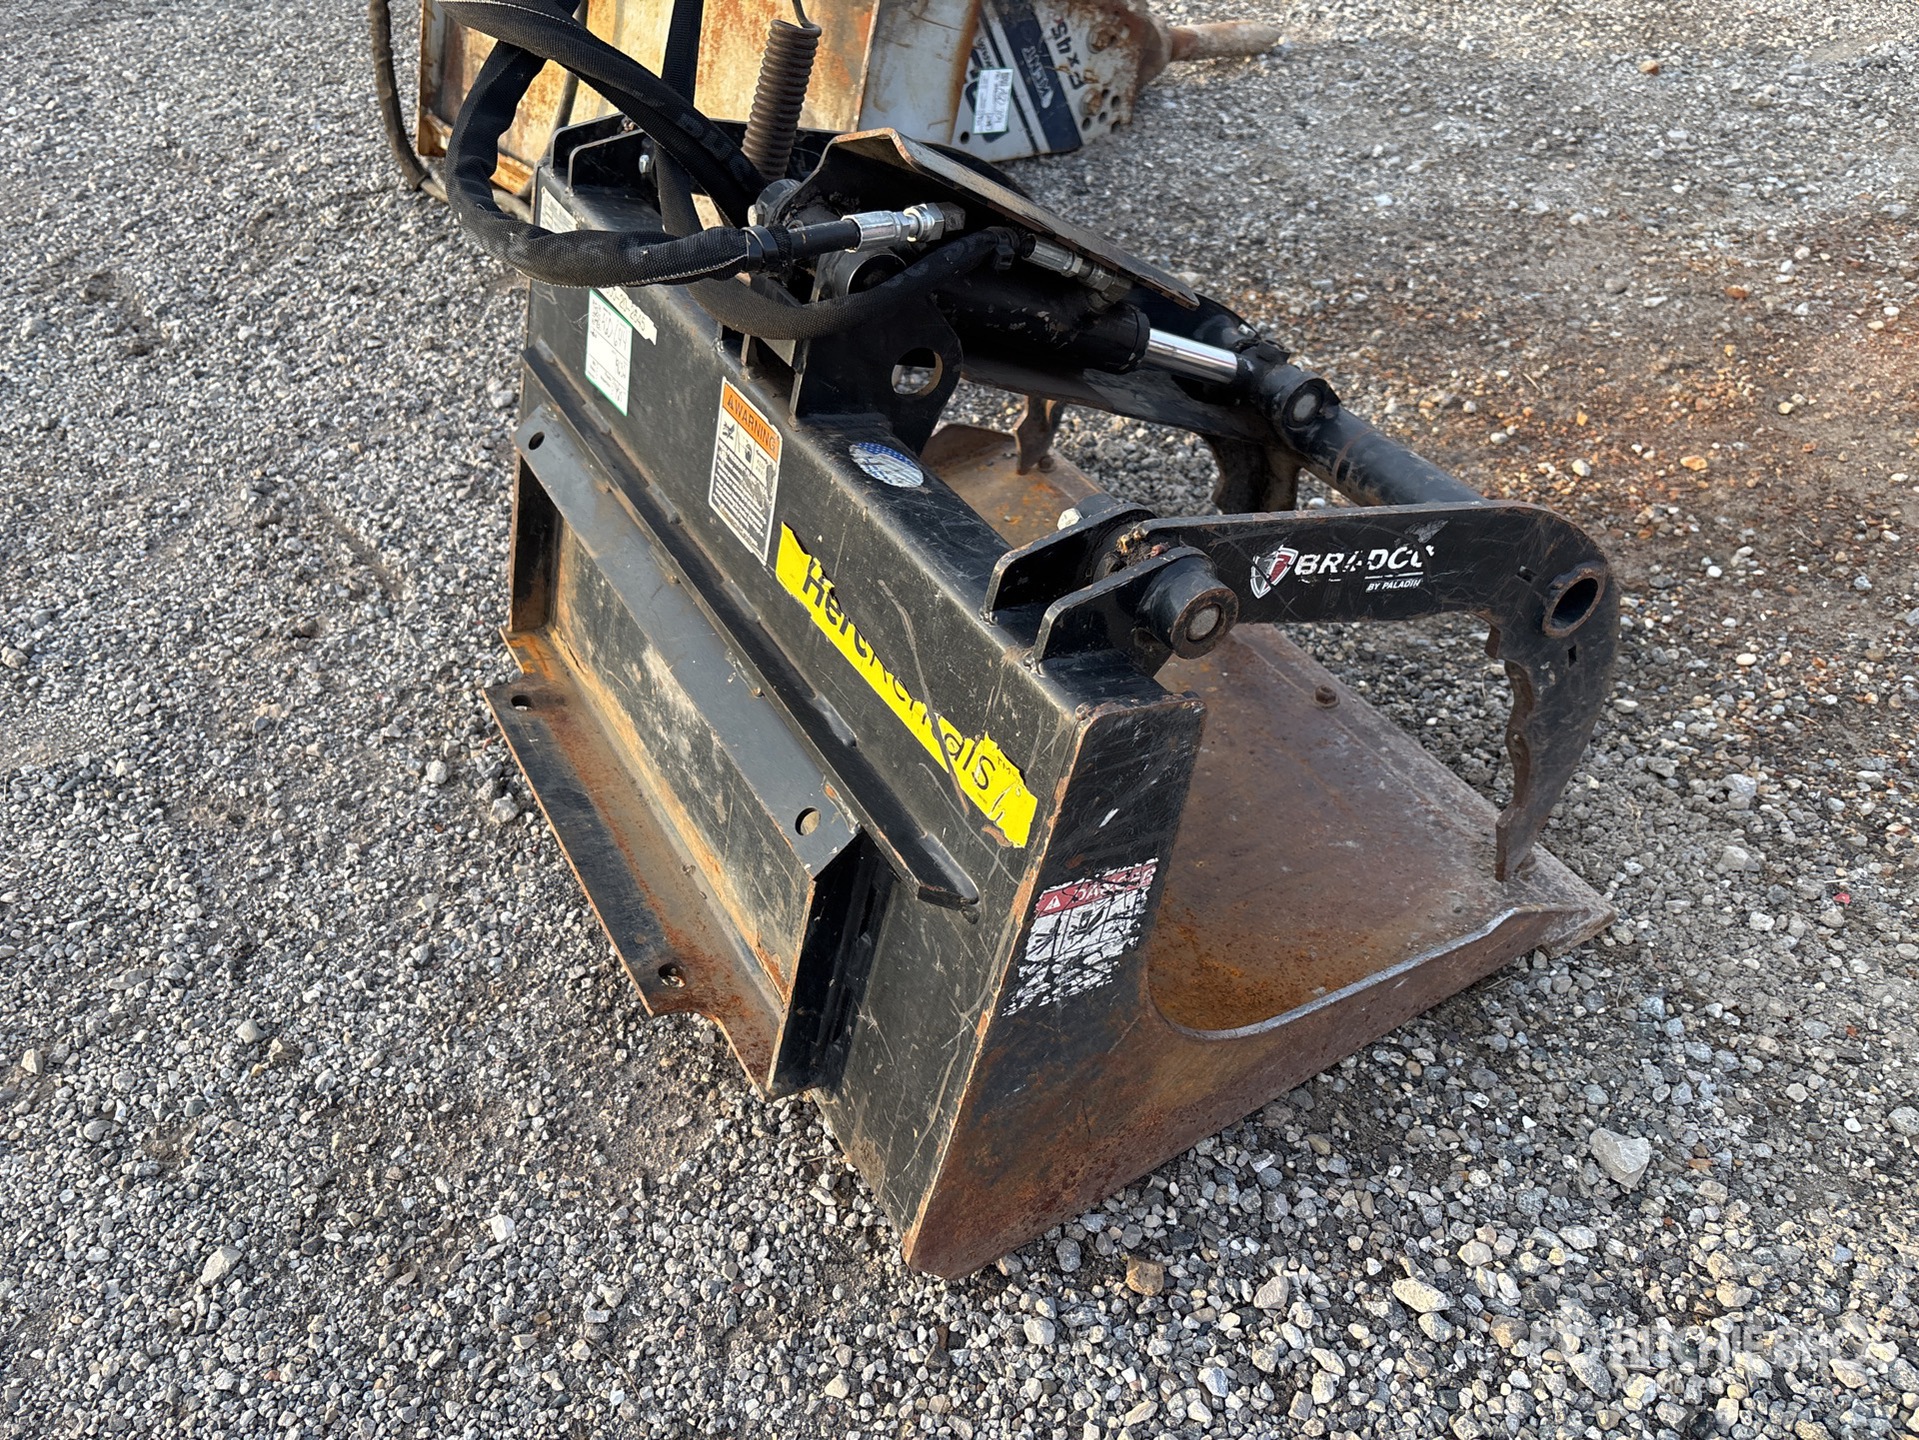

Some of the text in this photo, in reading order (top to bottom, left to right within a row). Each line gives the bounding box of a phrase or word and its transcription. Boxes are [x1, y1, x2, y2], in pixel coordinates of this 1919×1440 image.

[734, 399, 776, 453] WARNING
[1366, 578, 1422, 592] BY PALADIN
[802, 555, 997, 791] Herceals
